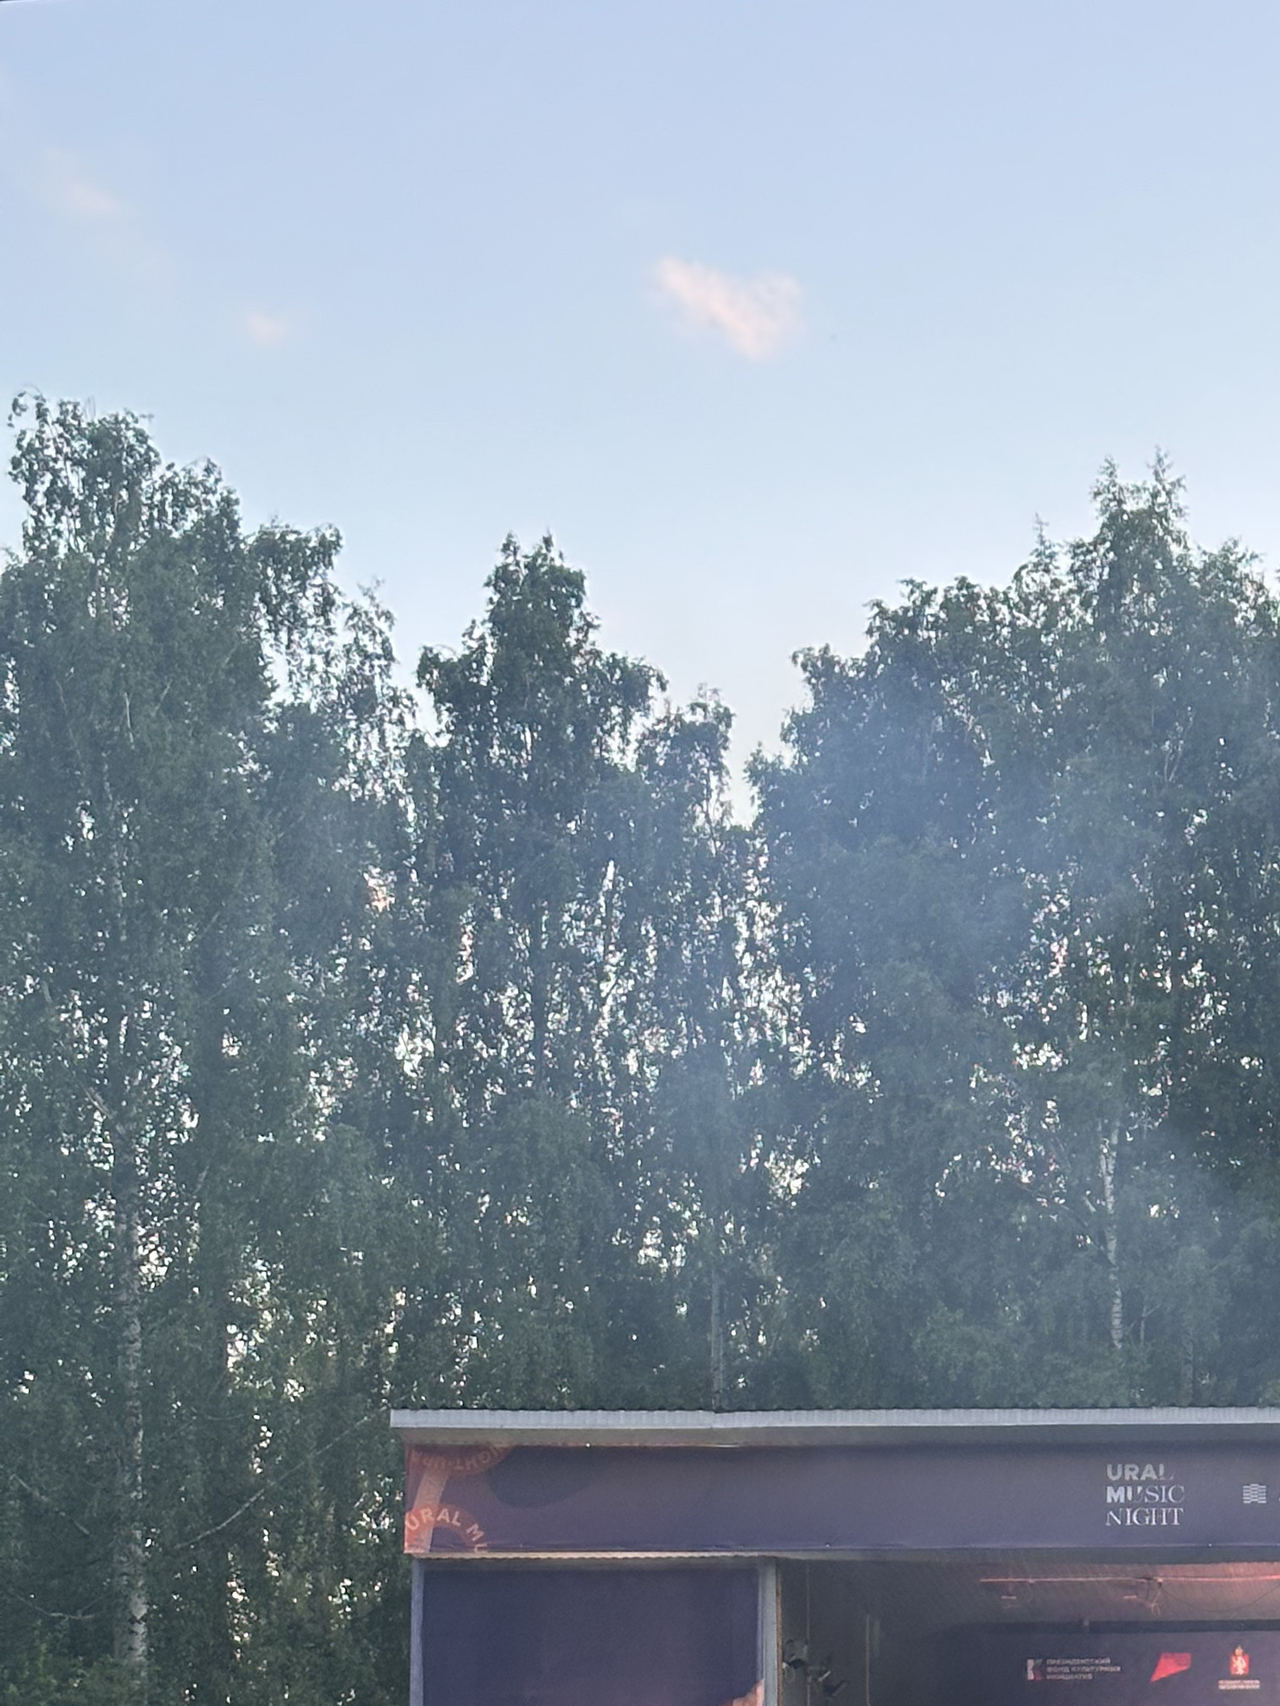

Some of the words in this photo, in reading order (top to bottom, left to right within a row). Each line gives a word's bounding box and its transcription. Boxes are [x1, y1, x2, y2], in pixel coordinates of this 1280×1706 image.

[1105, 1463, 1174, 1481] URAL
[1105, 1485, 1185, 1503] MUSIC
[1105, 1507, 1184, 1526] NIGHT
